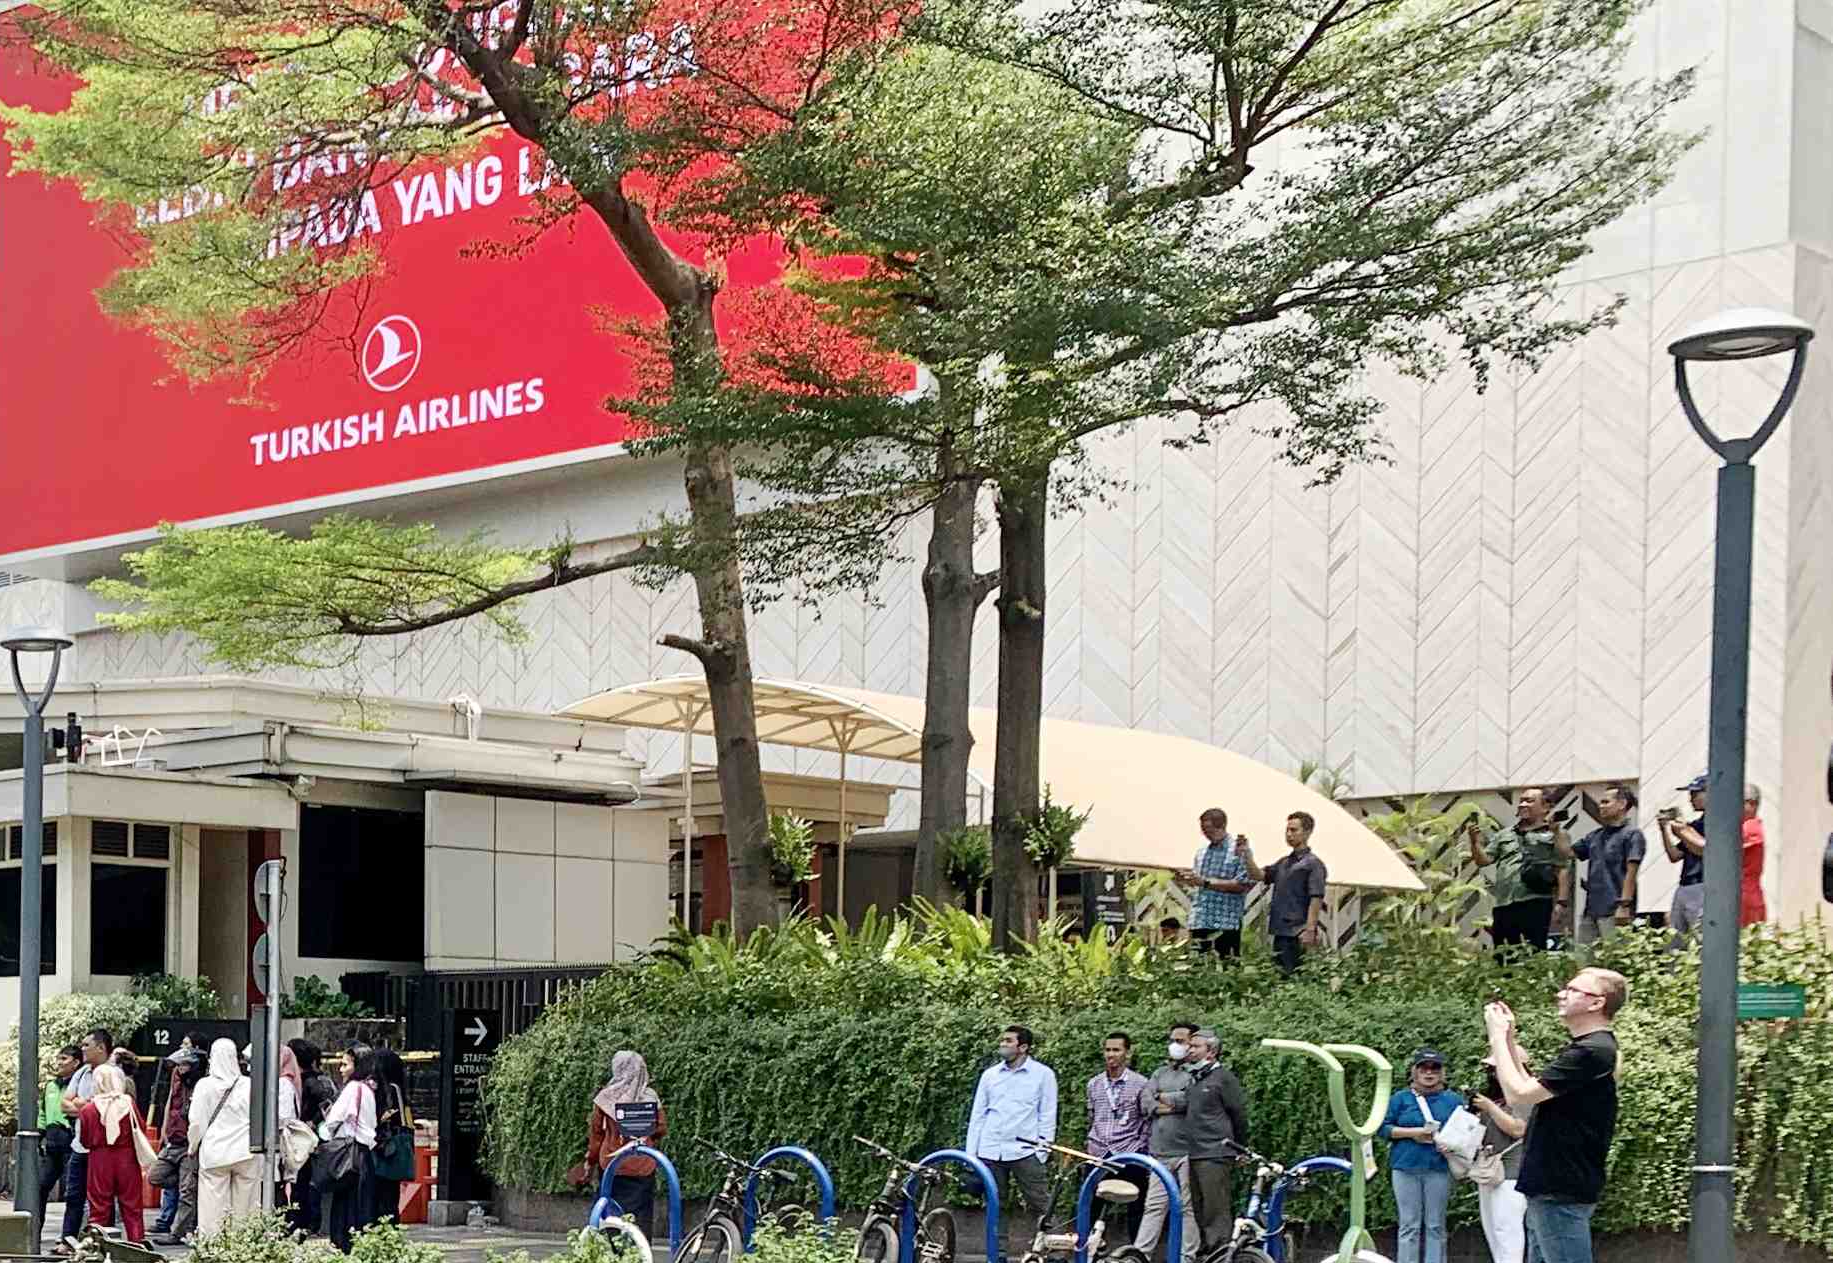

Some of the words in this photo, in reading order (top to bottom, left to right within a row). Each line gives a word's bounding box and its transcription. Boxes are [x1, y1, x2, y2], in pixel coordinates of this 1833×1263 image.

[392, 155, 503, 226] YANG
[250, 409, 385, 465] TURKISH
[392, 377, 545, 439] AIRLINES
[154, 1029, 170, 1045] 12
